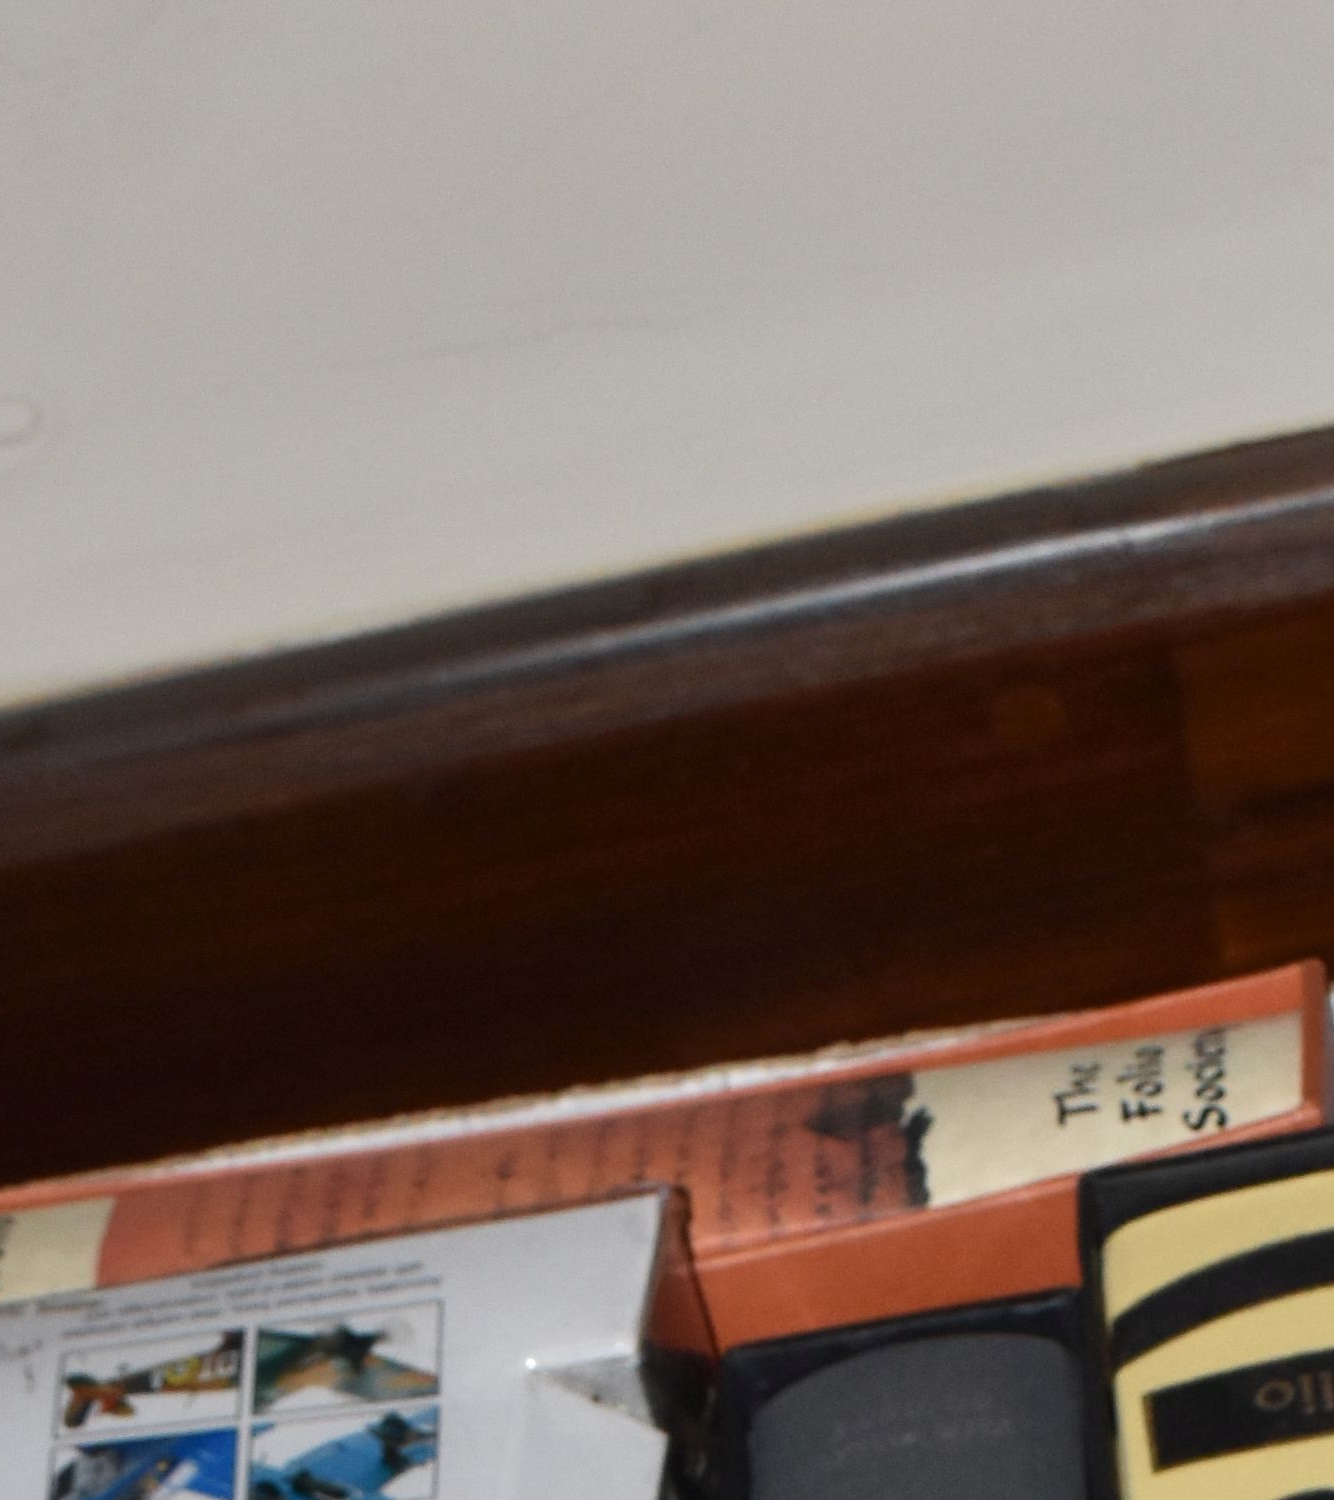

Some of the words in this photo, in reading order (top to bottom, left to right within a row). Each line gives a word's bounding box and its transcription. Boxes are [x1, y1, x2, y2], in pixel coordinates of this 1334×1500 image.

[1055, 1060, 1106, 1129] The
[1119, 1042, 1167, 1127] Folio
[1182, 1024, 1231, 1133] Society
